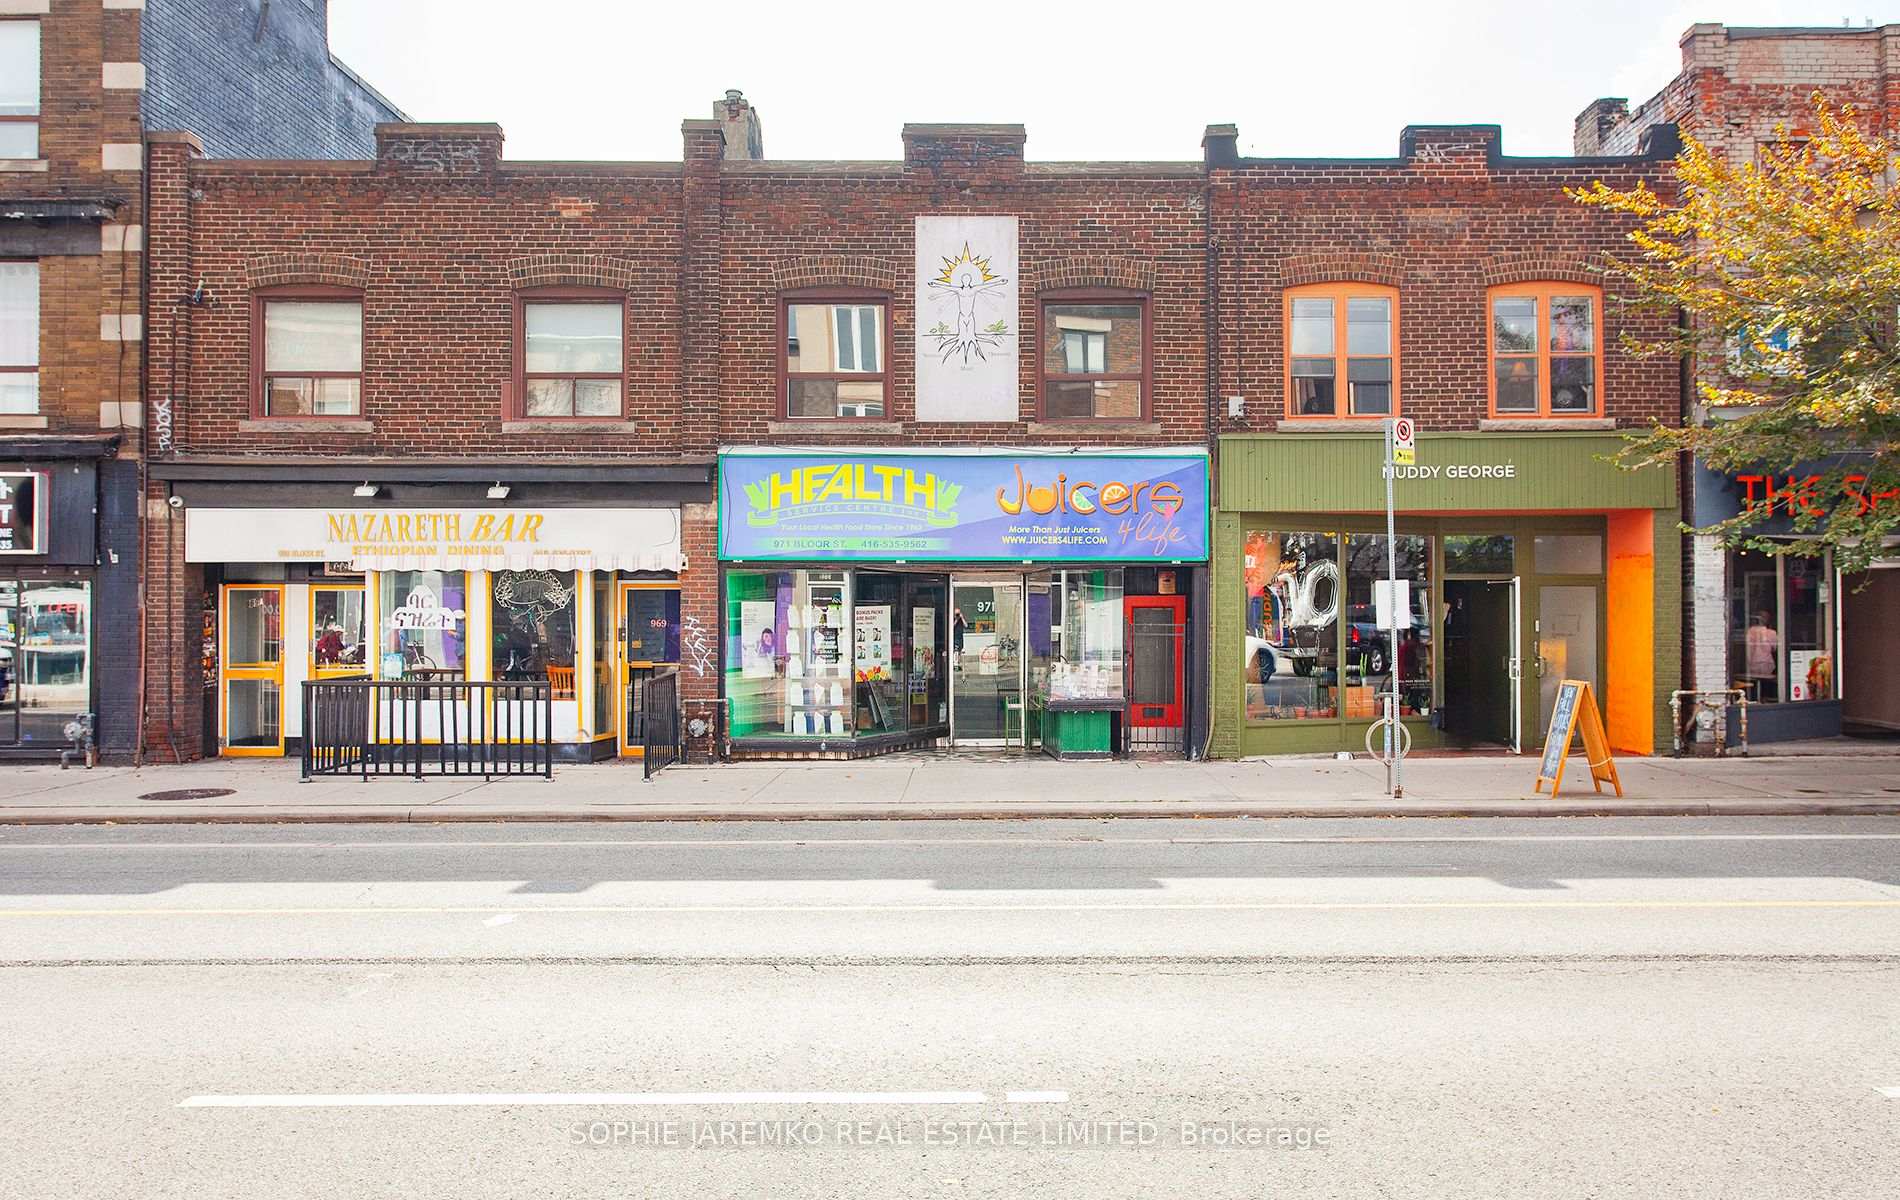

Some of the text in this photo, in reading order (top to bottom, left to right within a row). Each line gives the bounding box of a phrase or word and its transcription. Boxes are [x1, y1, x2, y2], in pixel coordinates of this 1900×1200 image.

[769, 464, 937, 510] HEALTH
[996, 464, 1184, 515] Juicers
[327, 512, 545, 543] NAZARETH BAR
[1002, 535, 1108, 544] WWW.JUICERS4LIFE.COM
[352, 545, 504, 555] ETHIOPIAN DINING
[650, 619, 667, 628] 969
